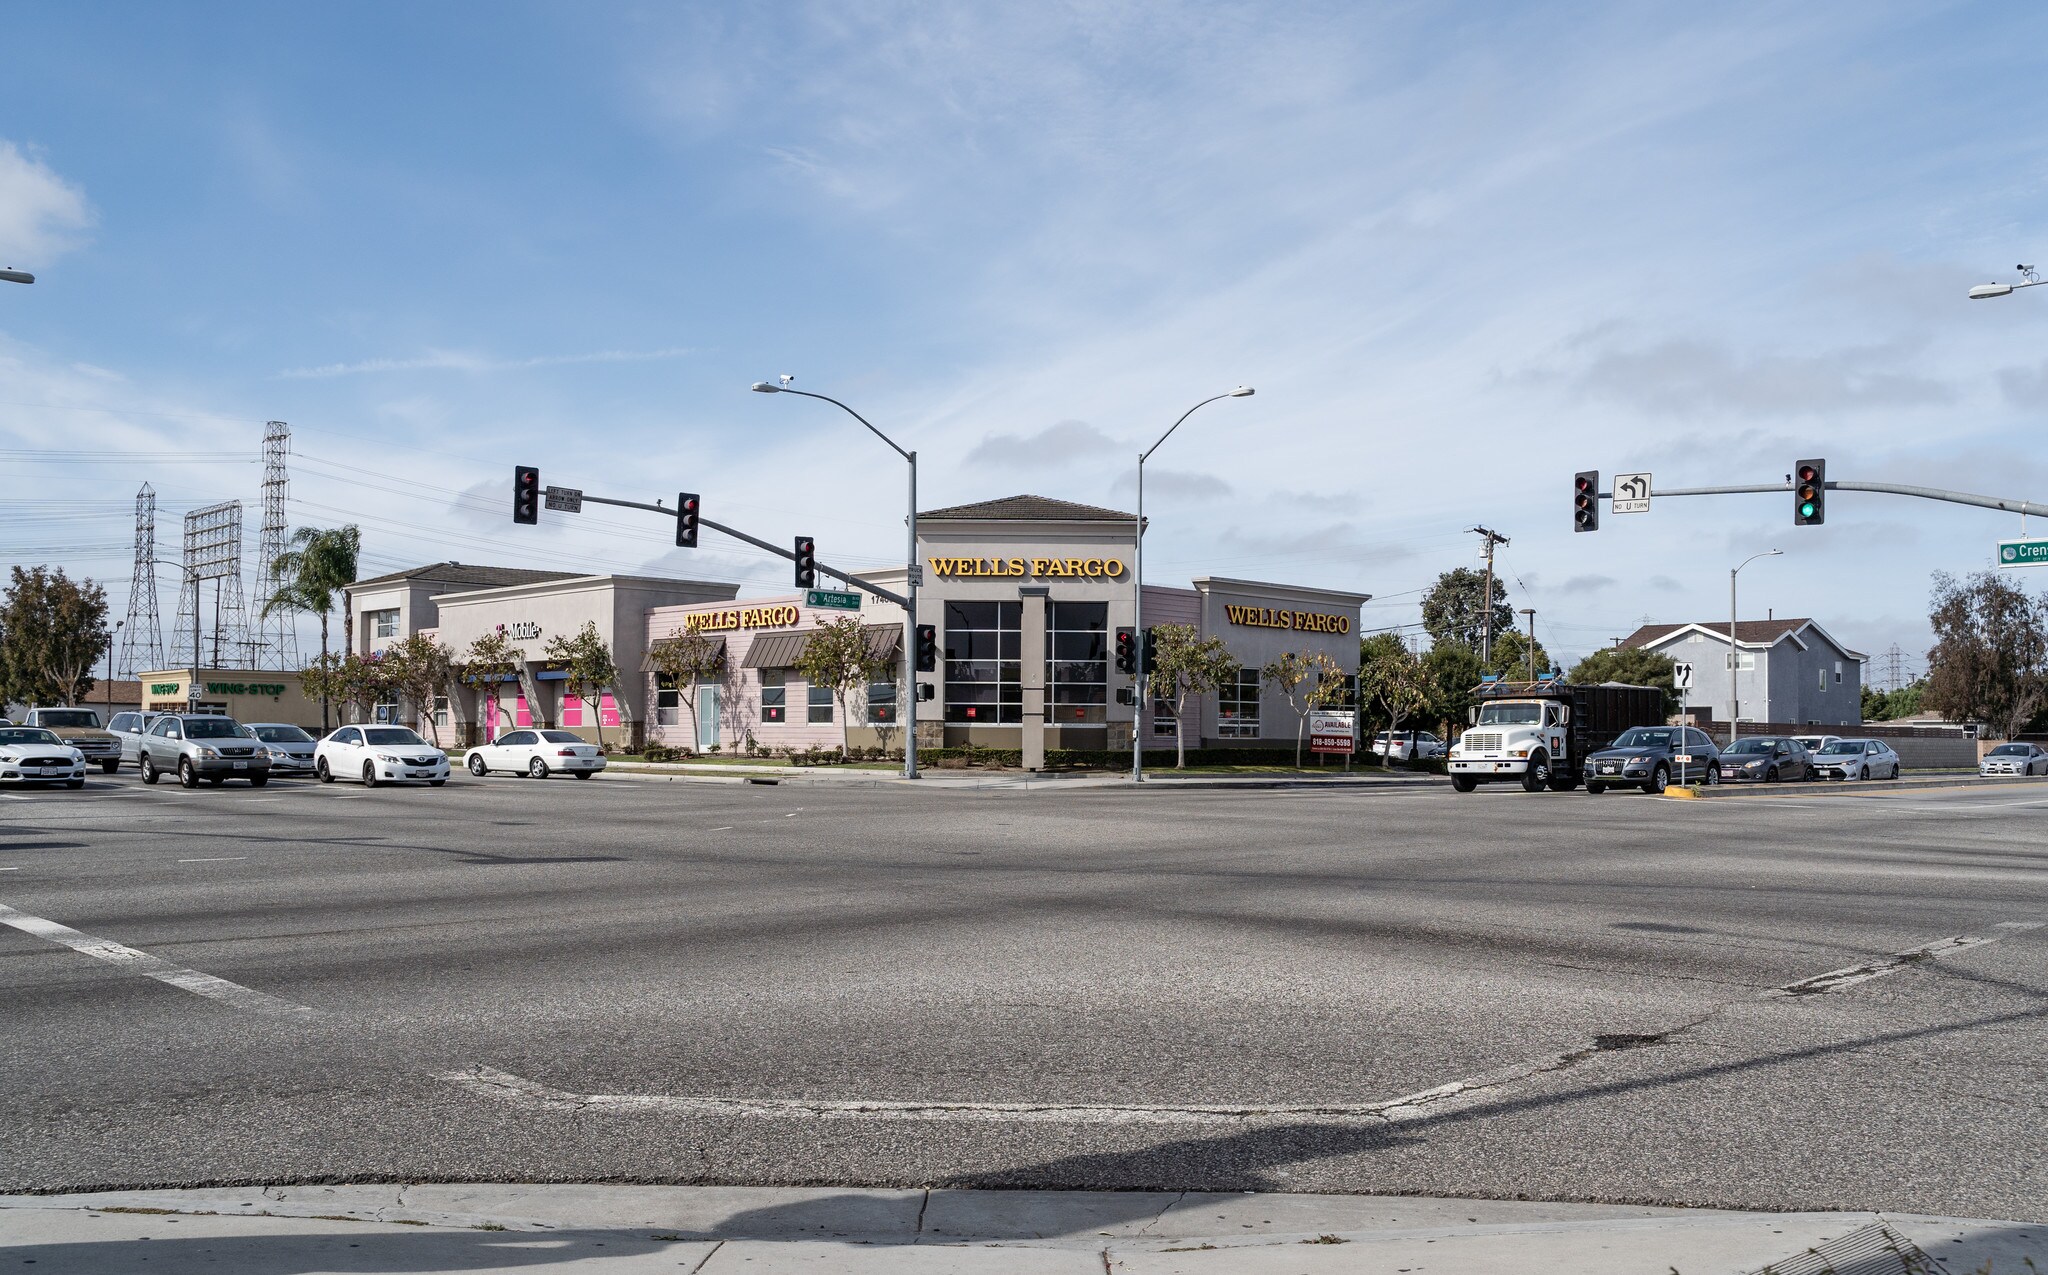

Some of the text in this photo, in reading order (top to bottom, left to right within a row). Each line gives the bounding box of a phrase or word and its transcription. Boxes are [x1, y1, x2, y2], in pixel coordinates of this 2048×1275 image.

[1626, 502, 1632, 511] U
[2019, 544, 2048, 557] Cren
[928, 557, 1125, 578] WELLS FARGO
[823, 593, 847, 604] Artesia
[684, 606, 799, 631] WELLS FARGO
[1226, 605, 1351, 635] WELLS FARGO
[189, 691, 201, 699] 40
[1324, 721, 1351, 729] AVAILABLE
